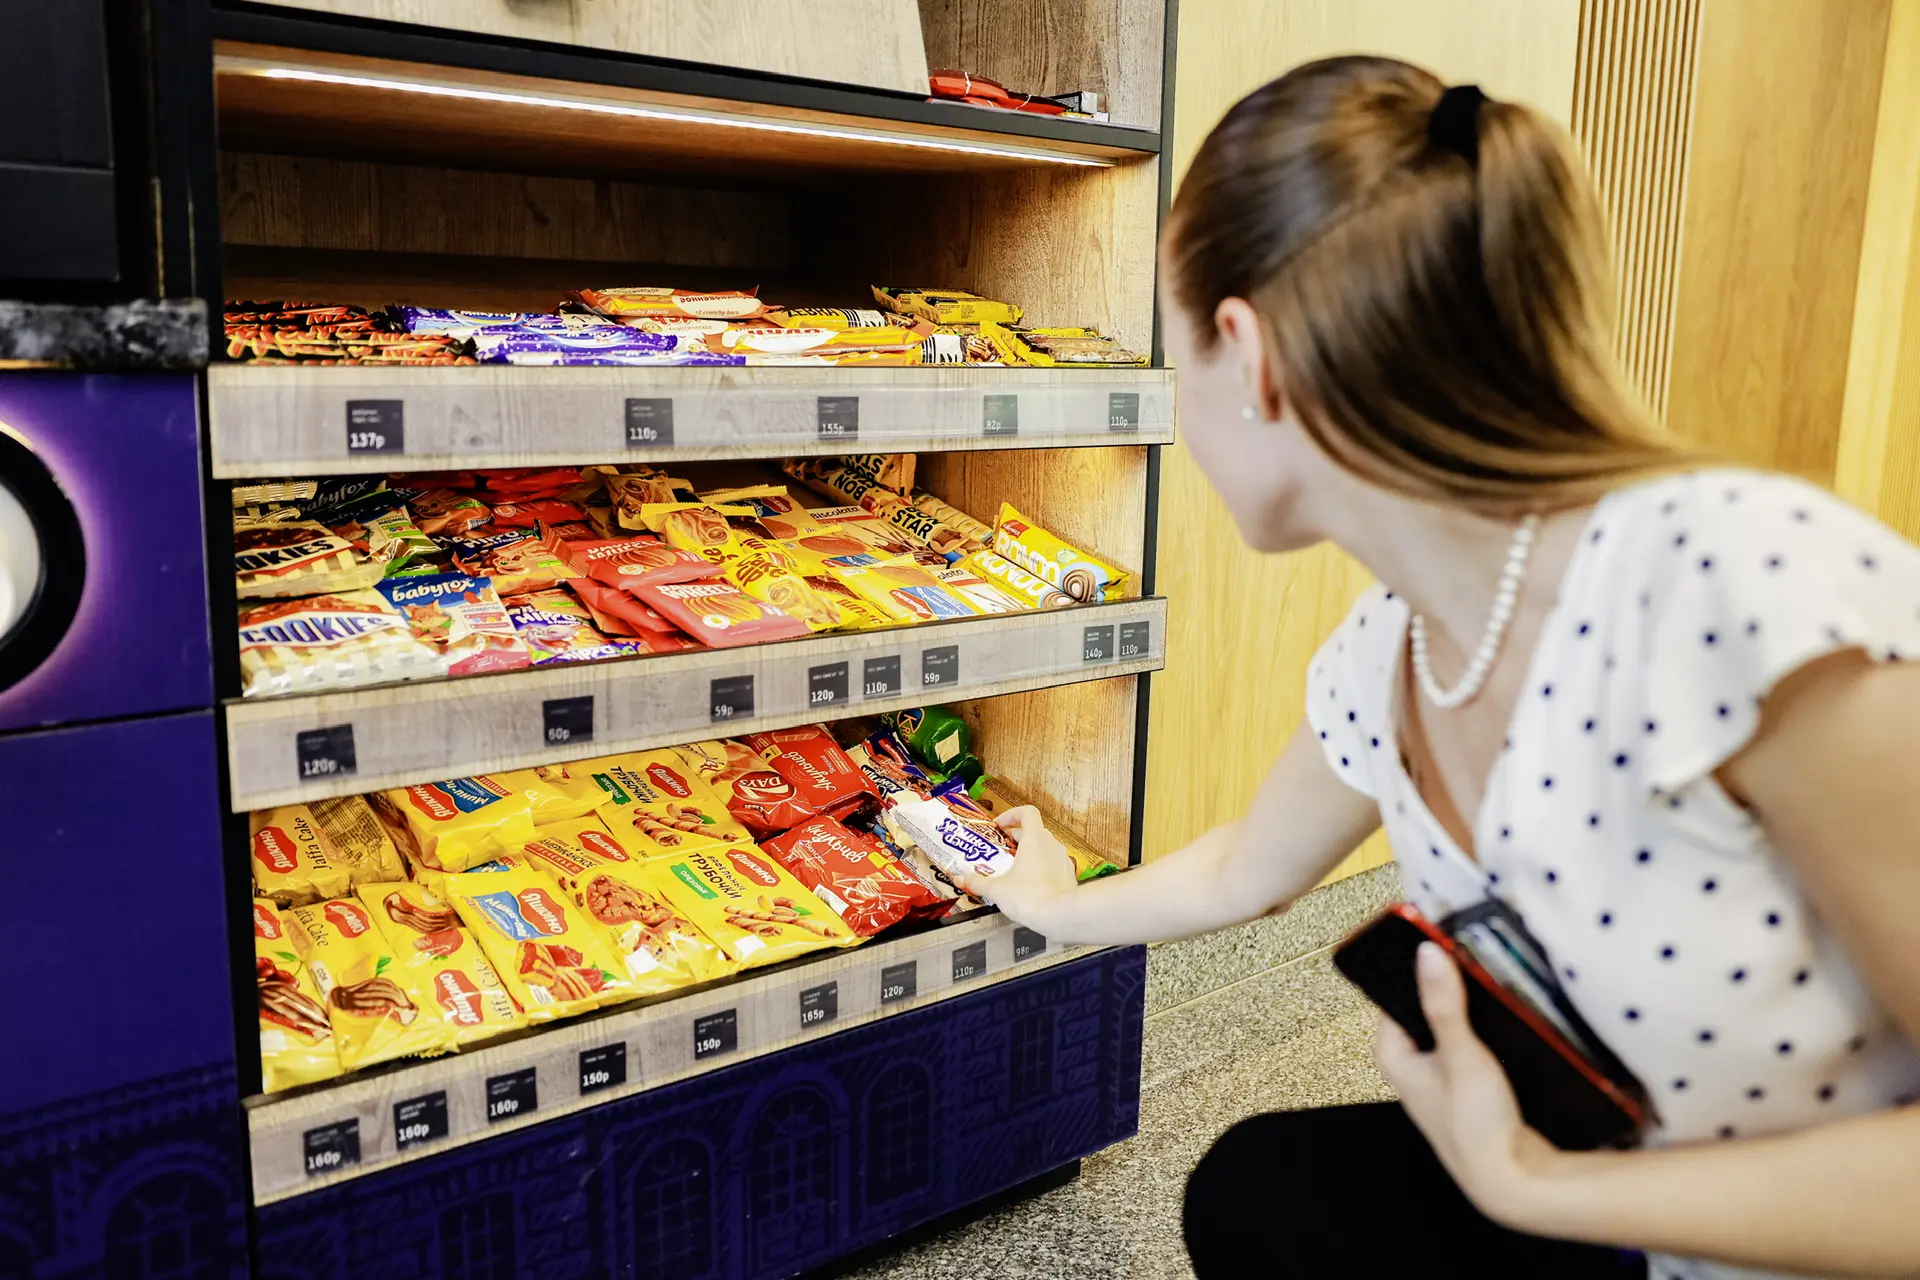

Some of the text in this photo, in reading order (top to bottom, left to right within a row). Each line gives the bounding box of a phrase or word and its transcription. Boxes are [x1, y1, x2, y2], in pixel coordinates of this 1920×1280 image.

[703, 309, 725, 318] crunchy
[727, 309, 740, 317] bars
[833, 474, 868, 501] BON
[891, 509, 934, 539] STAR
[736, 552, 788, 577] Cake
[997, 531, 1061, 585] RONDO
[392, 578, 476, 602] babyfox
[811, 689, 834, 702] 120р
[866, 682, 888, 695] 110р
[610, 765, 653, 804] ТРУБОЧКИ
[649, 768, 688, 796] Яшкино
[740, 776, 783, 788] DAYS
[782, 751, 837, 792] Акульчев
[260, 829, 294, 869] Яшкино
[294, 817, 333, 870] Jaffa Cake
[580, 833, 626, 860] Яшкино
[801, 823, 868, 864] Акульчев
[688, 853, 743, 899] ТРУБОЧКИ
[728, 853, 777, 884] Яшкино
[521, 892, 564, 934] Яшкино
[307, 922, 329, 947] Cake
